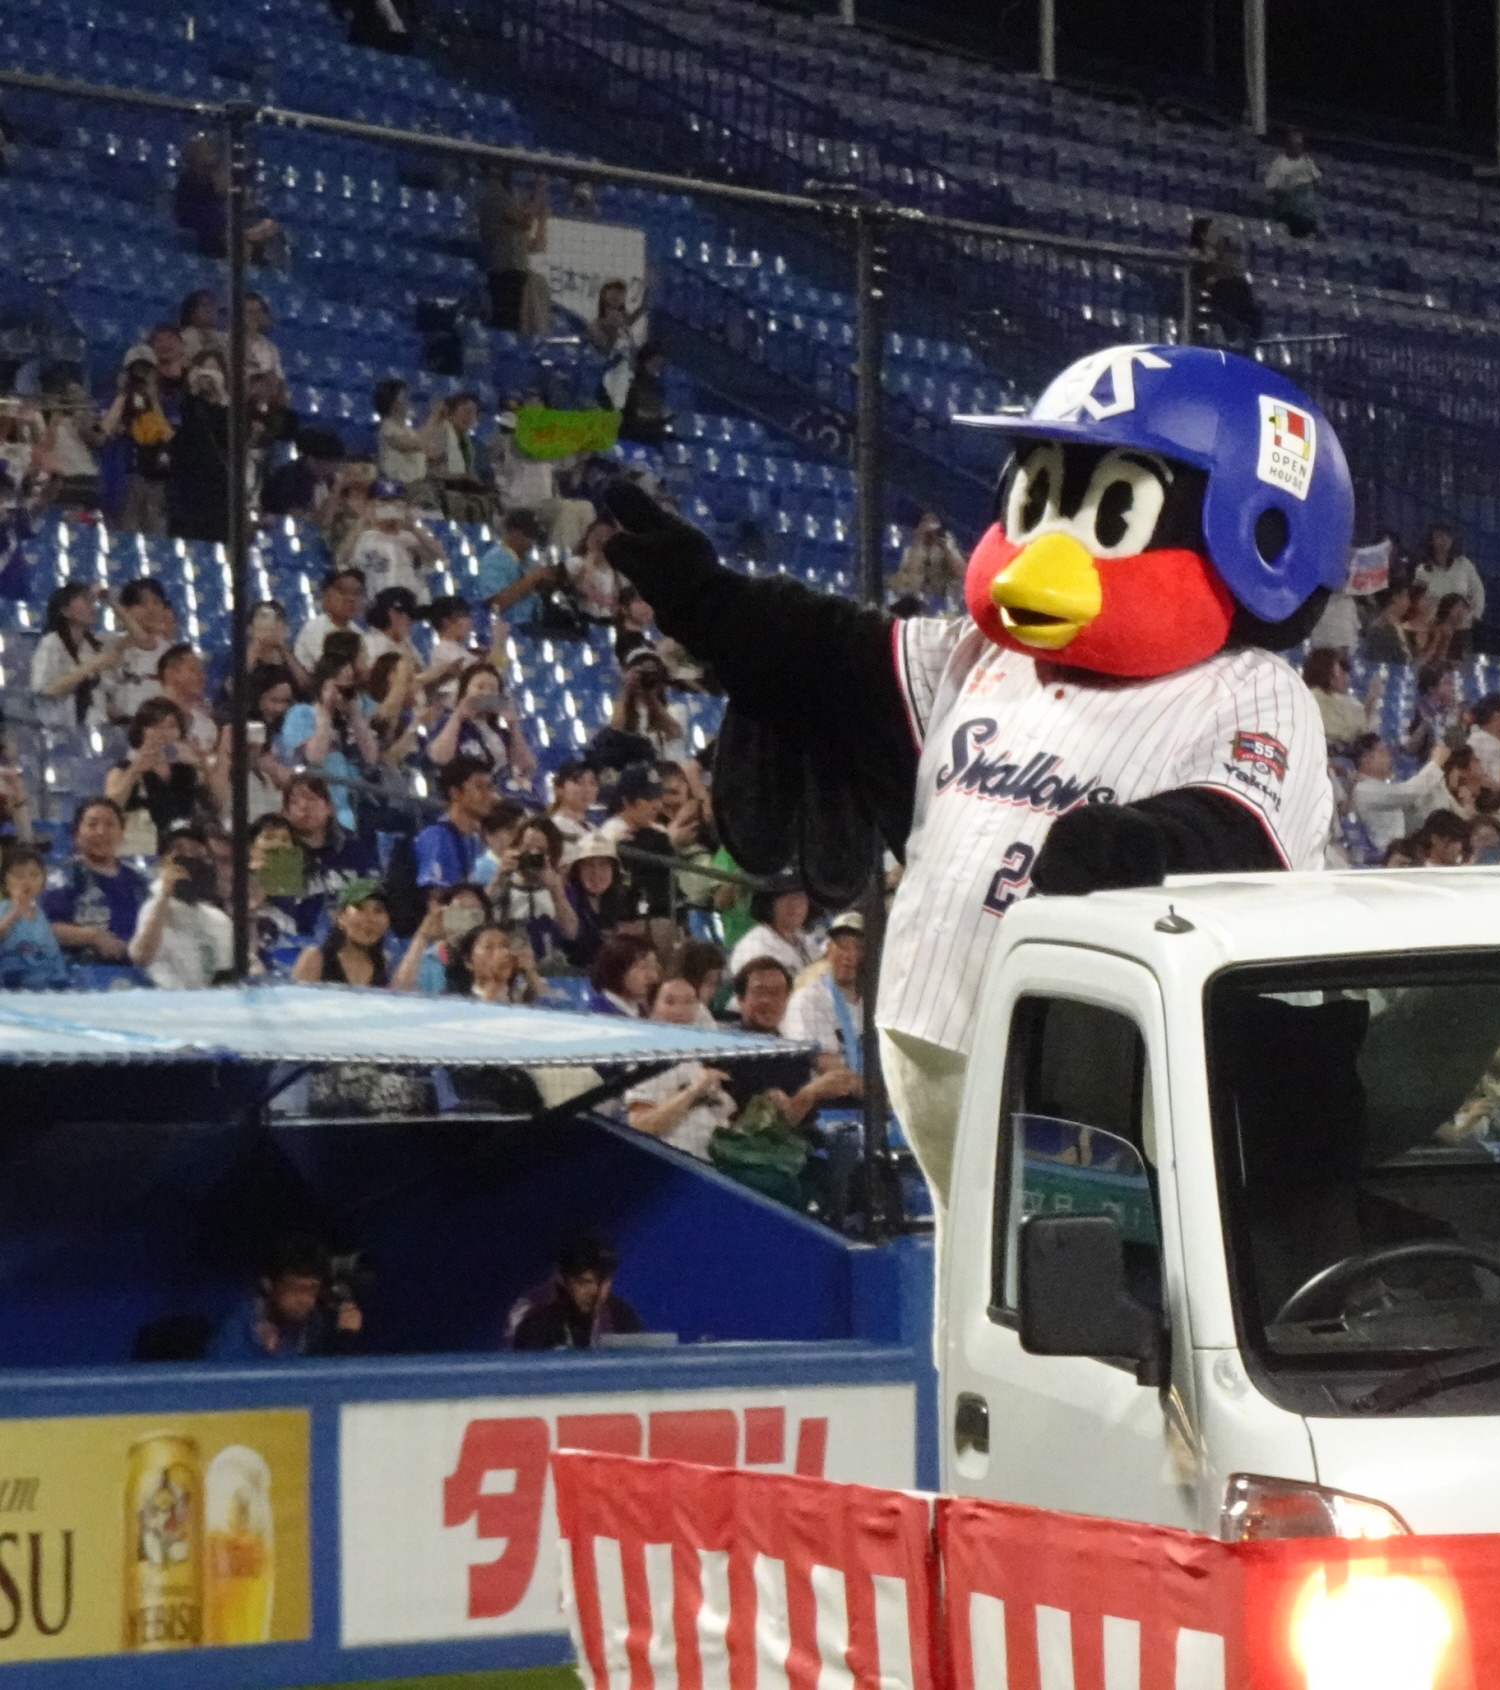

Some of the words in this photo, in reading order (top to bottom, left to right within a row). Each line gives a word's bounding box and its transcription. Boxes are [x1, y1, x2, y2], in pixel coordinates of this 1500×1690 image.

[1271, 451, 1307, 478] OPEN
[1269, 466, 1303, 491] HOUSE
[1254, 741, 1274, 759] 55
[936, 717, 1118, 818] Swallows
